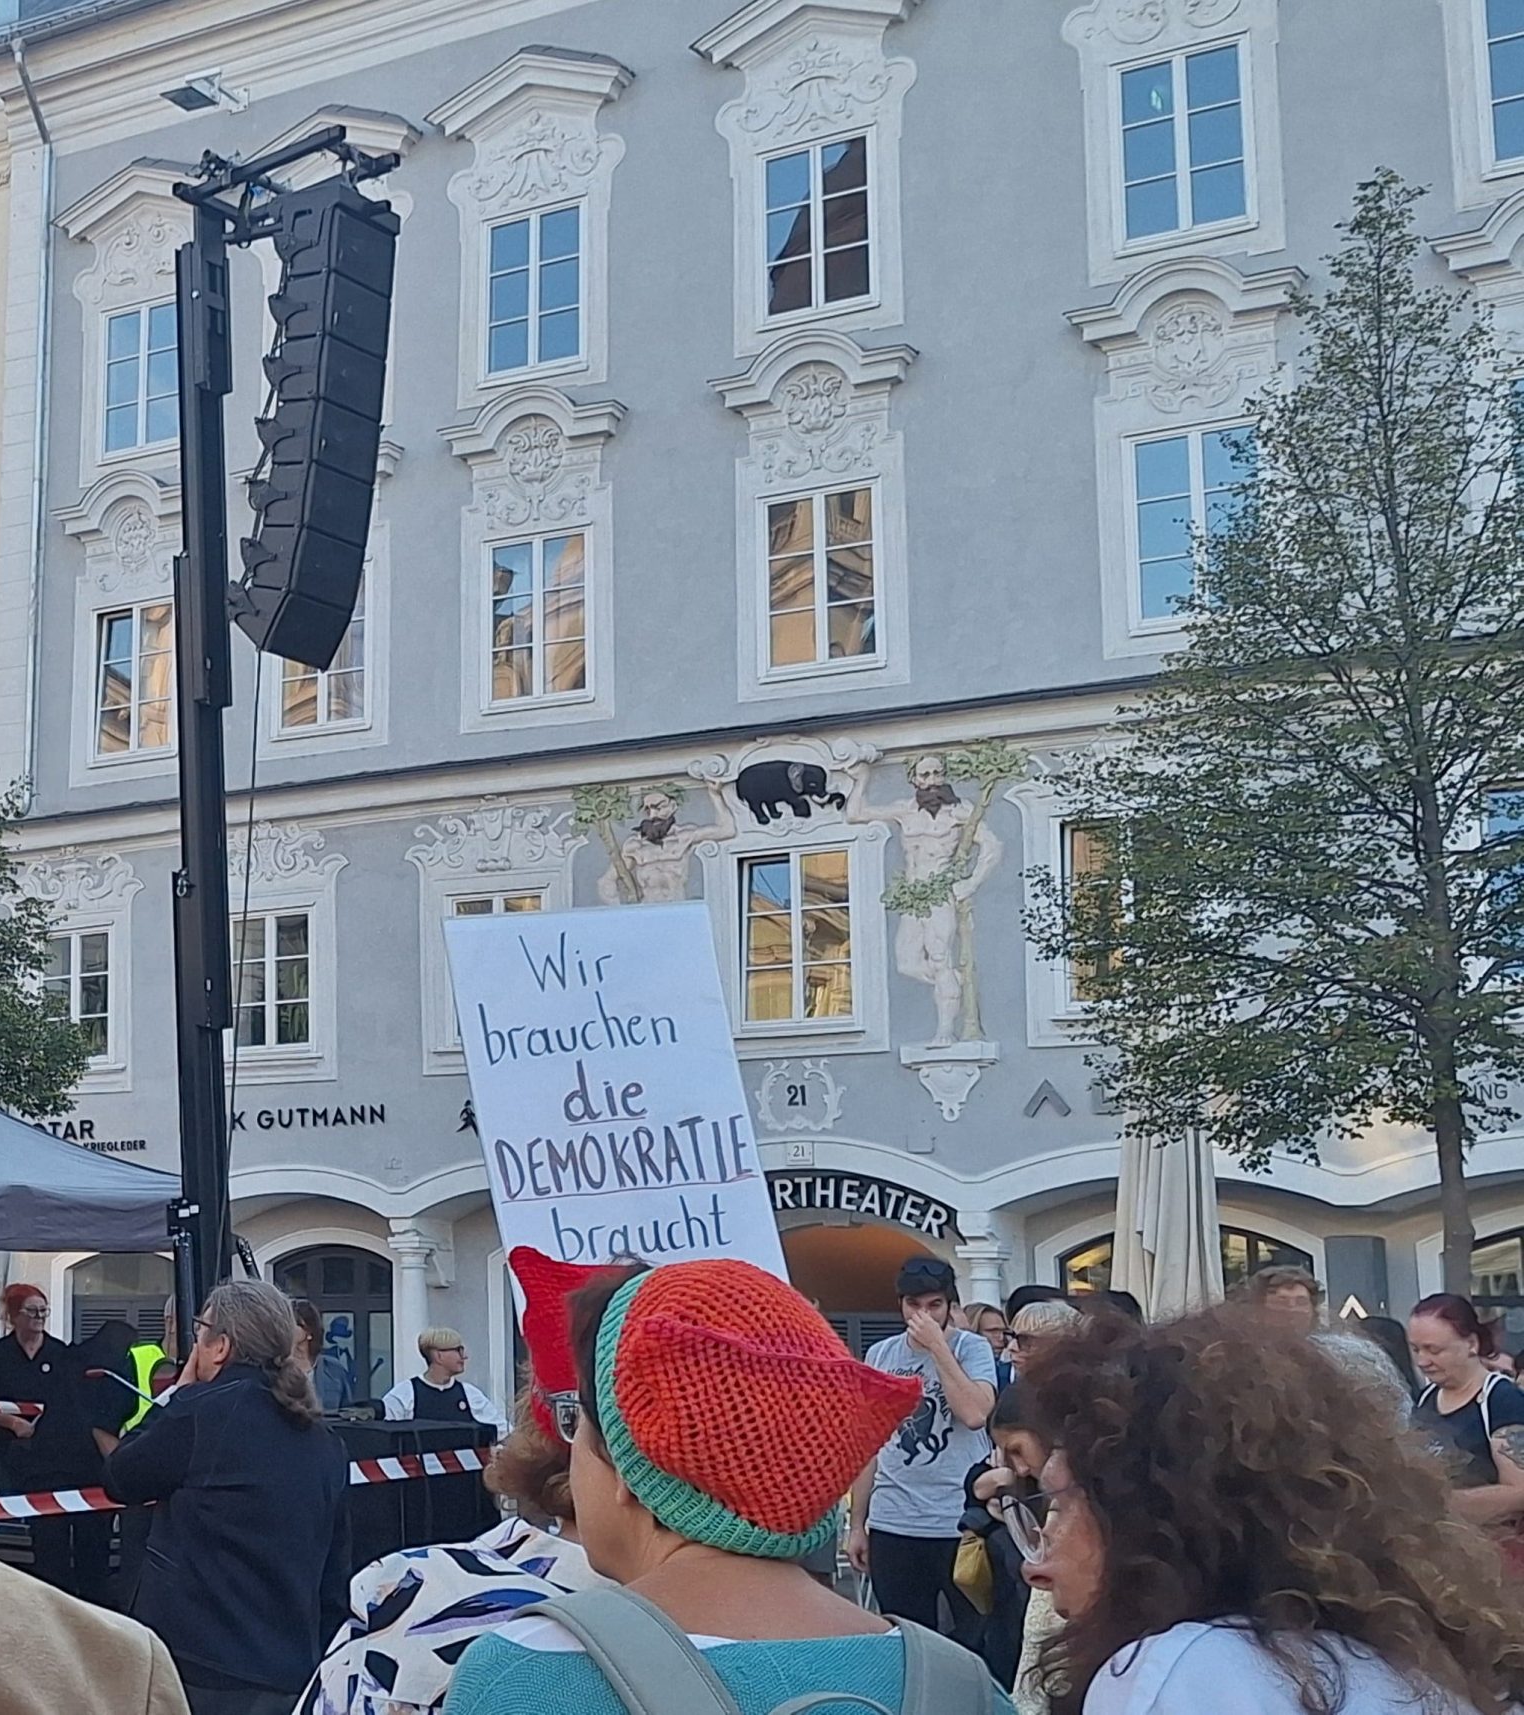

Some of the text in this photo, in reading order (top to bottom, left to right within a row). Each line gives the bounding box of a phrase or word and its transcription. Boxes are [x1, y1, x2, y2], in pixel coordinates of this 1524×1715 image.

[518, 931, 612, 992] Wir
[478, 991, 678, 1065] brauchen
[256, 1104, 386, 1130] GUTMANN
[563, 1059, 648, 1123] die
[786, 1084, 807, 1107] 21
[494, 1114, 753, 1200] DEMOKRATIE
[793, 1145, 805, 1157] 21
[551, 1193, 732, 1262] braucht
[774, 1176, 949, 1240] RTHEATER
